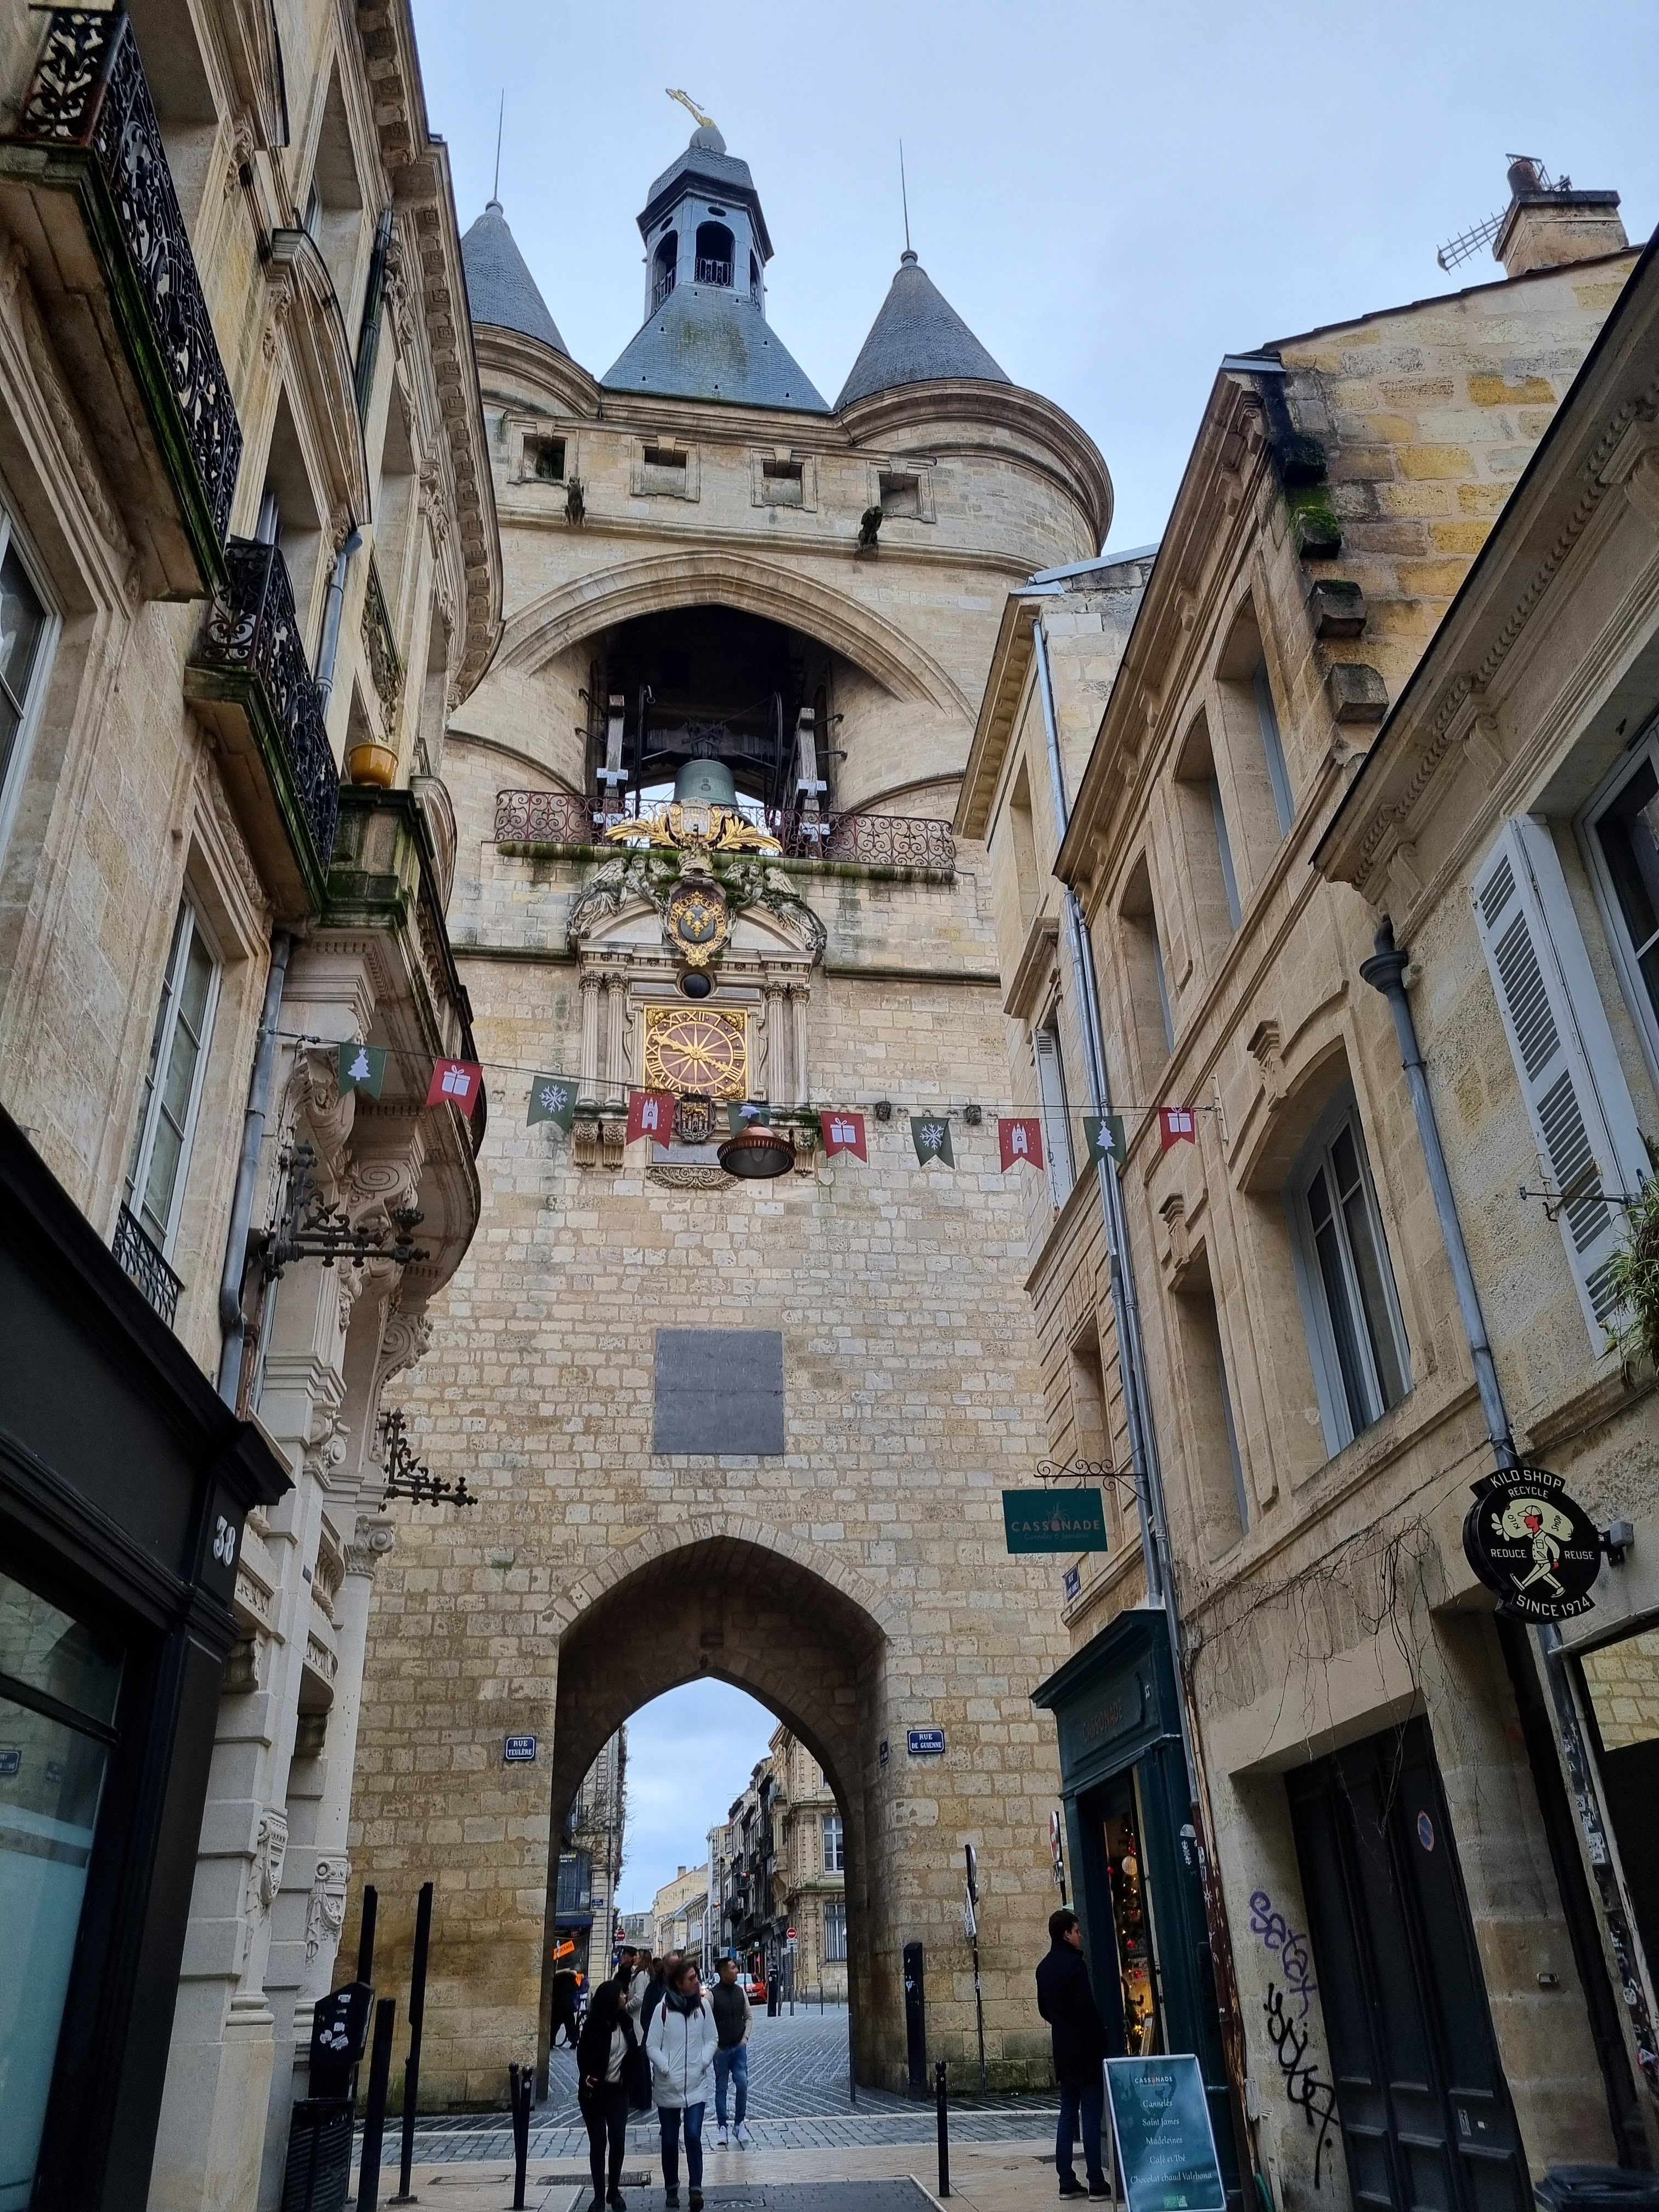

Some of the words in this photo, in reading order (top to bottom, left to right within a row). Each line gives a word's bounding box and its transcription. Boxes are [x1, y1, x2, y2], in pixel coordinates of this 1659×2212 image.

[686, 1011, 705, 1022] XII
[1490, 1470, 1520, 1488] KILO
[1523, 1470, 1562, 1488] SHOP
[1508, 1486, 1549, 1499] RECYCLE
[1508, 1515, 1521, 1530] KILO
[1551, 1515, 1562, 1531] SHOP
[213, 1515, 236, 1566] 38
[1491, 1549, 1527, 1558] REDUCE
[1564, 1550, 1595, 1560] REUSE
[1516, 1594, 1559, 1616] SINCE
[1561, 1596, 1590, 1616] 1974
[1143, 2098, 1173, 2109] Cannelés
[1142, 2118, 1160, 2126] Saint
[1161, 2118, 1180, 2127] James
[1146, 2135, 1183, 2145] Madeleines
[1149, 2155, 1165, 2165] Café
[1174, 2153, 1186, 2162] Thé
[1130, 2175, 1160, 2184] Chocolat
[1161, 2172, 1181, 2182] chaud
[1182, 2171, 1212, 2181] Valrhona
